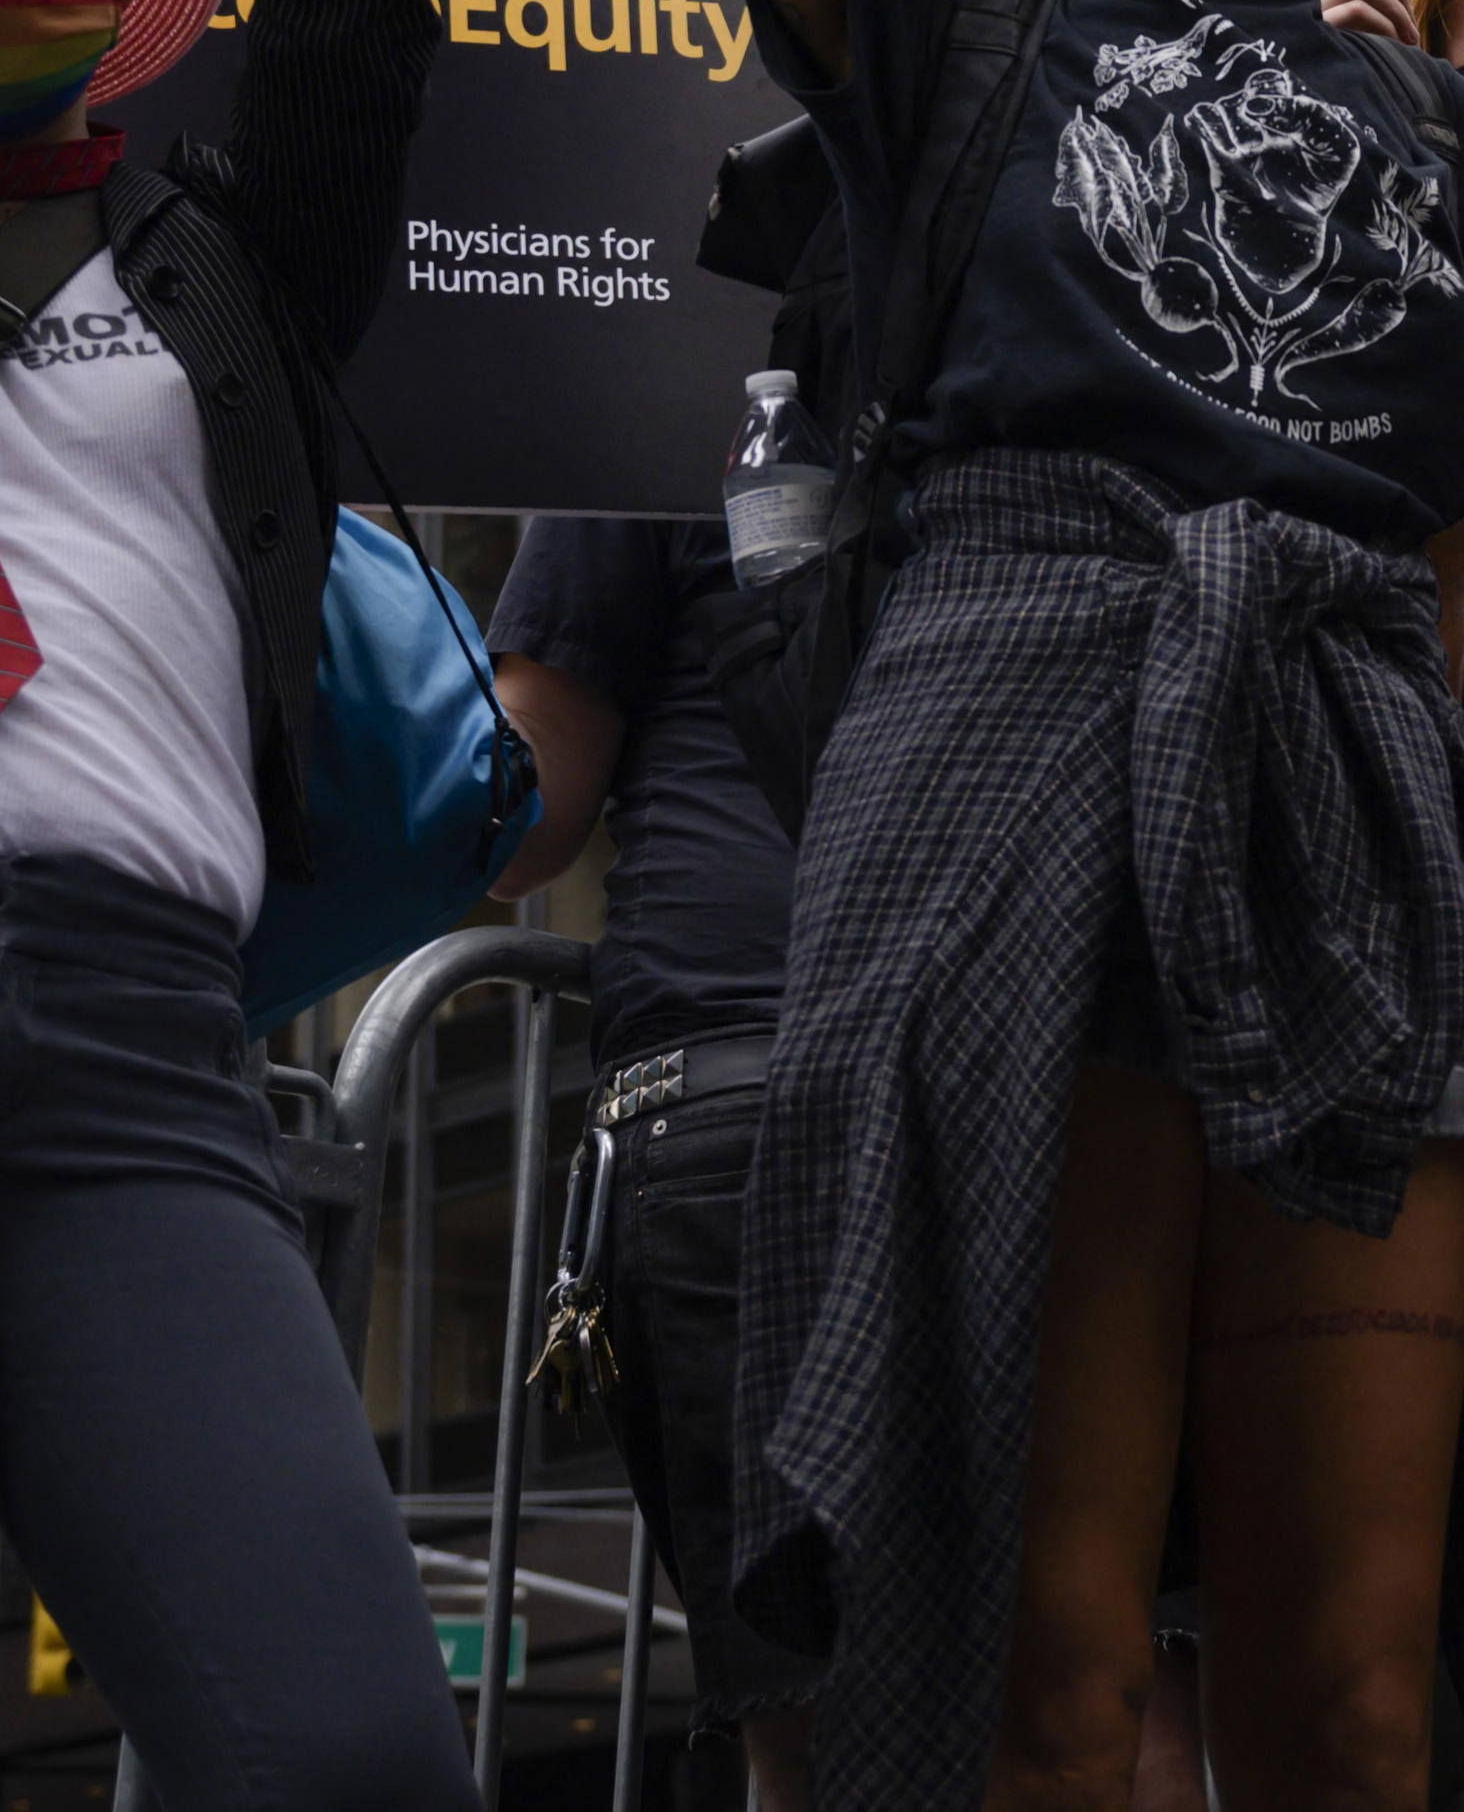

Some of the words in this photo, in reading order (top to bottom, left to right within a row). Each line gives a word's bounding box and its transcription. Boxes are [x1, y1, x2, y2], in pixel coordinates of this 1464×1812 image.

[406, 219, 592, 262] Physicians
[600, 227, 656, 262] for
[408, 259, 545, 296] Human
[557, 266, 672, 308] Rights
[15, 340, 159, 371] EXUAL
[1287, 419, 1324, 444] NOT
[1330, 413, 1393, 445] BOMBS
